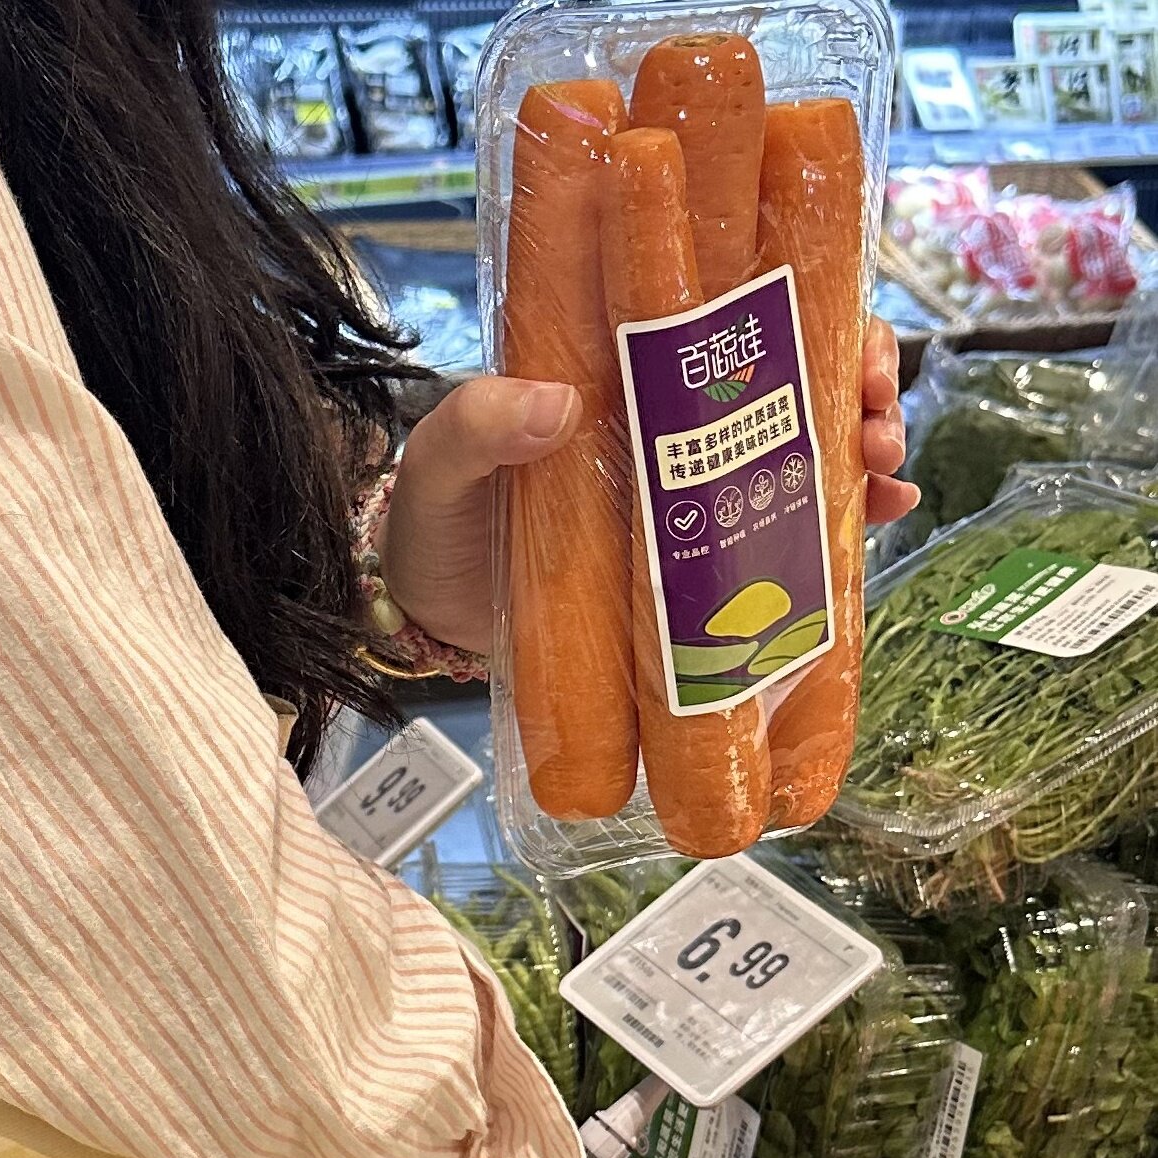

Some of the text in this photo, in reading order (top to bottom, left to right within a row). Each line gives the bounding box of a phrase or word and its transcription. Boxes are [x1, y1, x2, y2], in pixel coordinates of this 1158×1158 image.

[677, 313, 767, 389] 百蔬佳
[666, 395, 790, 459] 丰富多样的优质蔬菜
[669, 414, 793, 481] 传递健康美味的生活
[677, 918, 790, 989] 6.99
